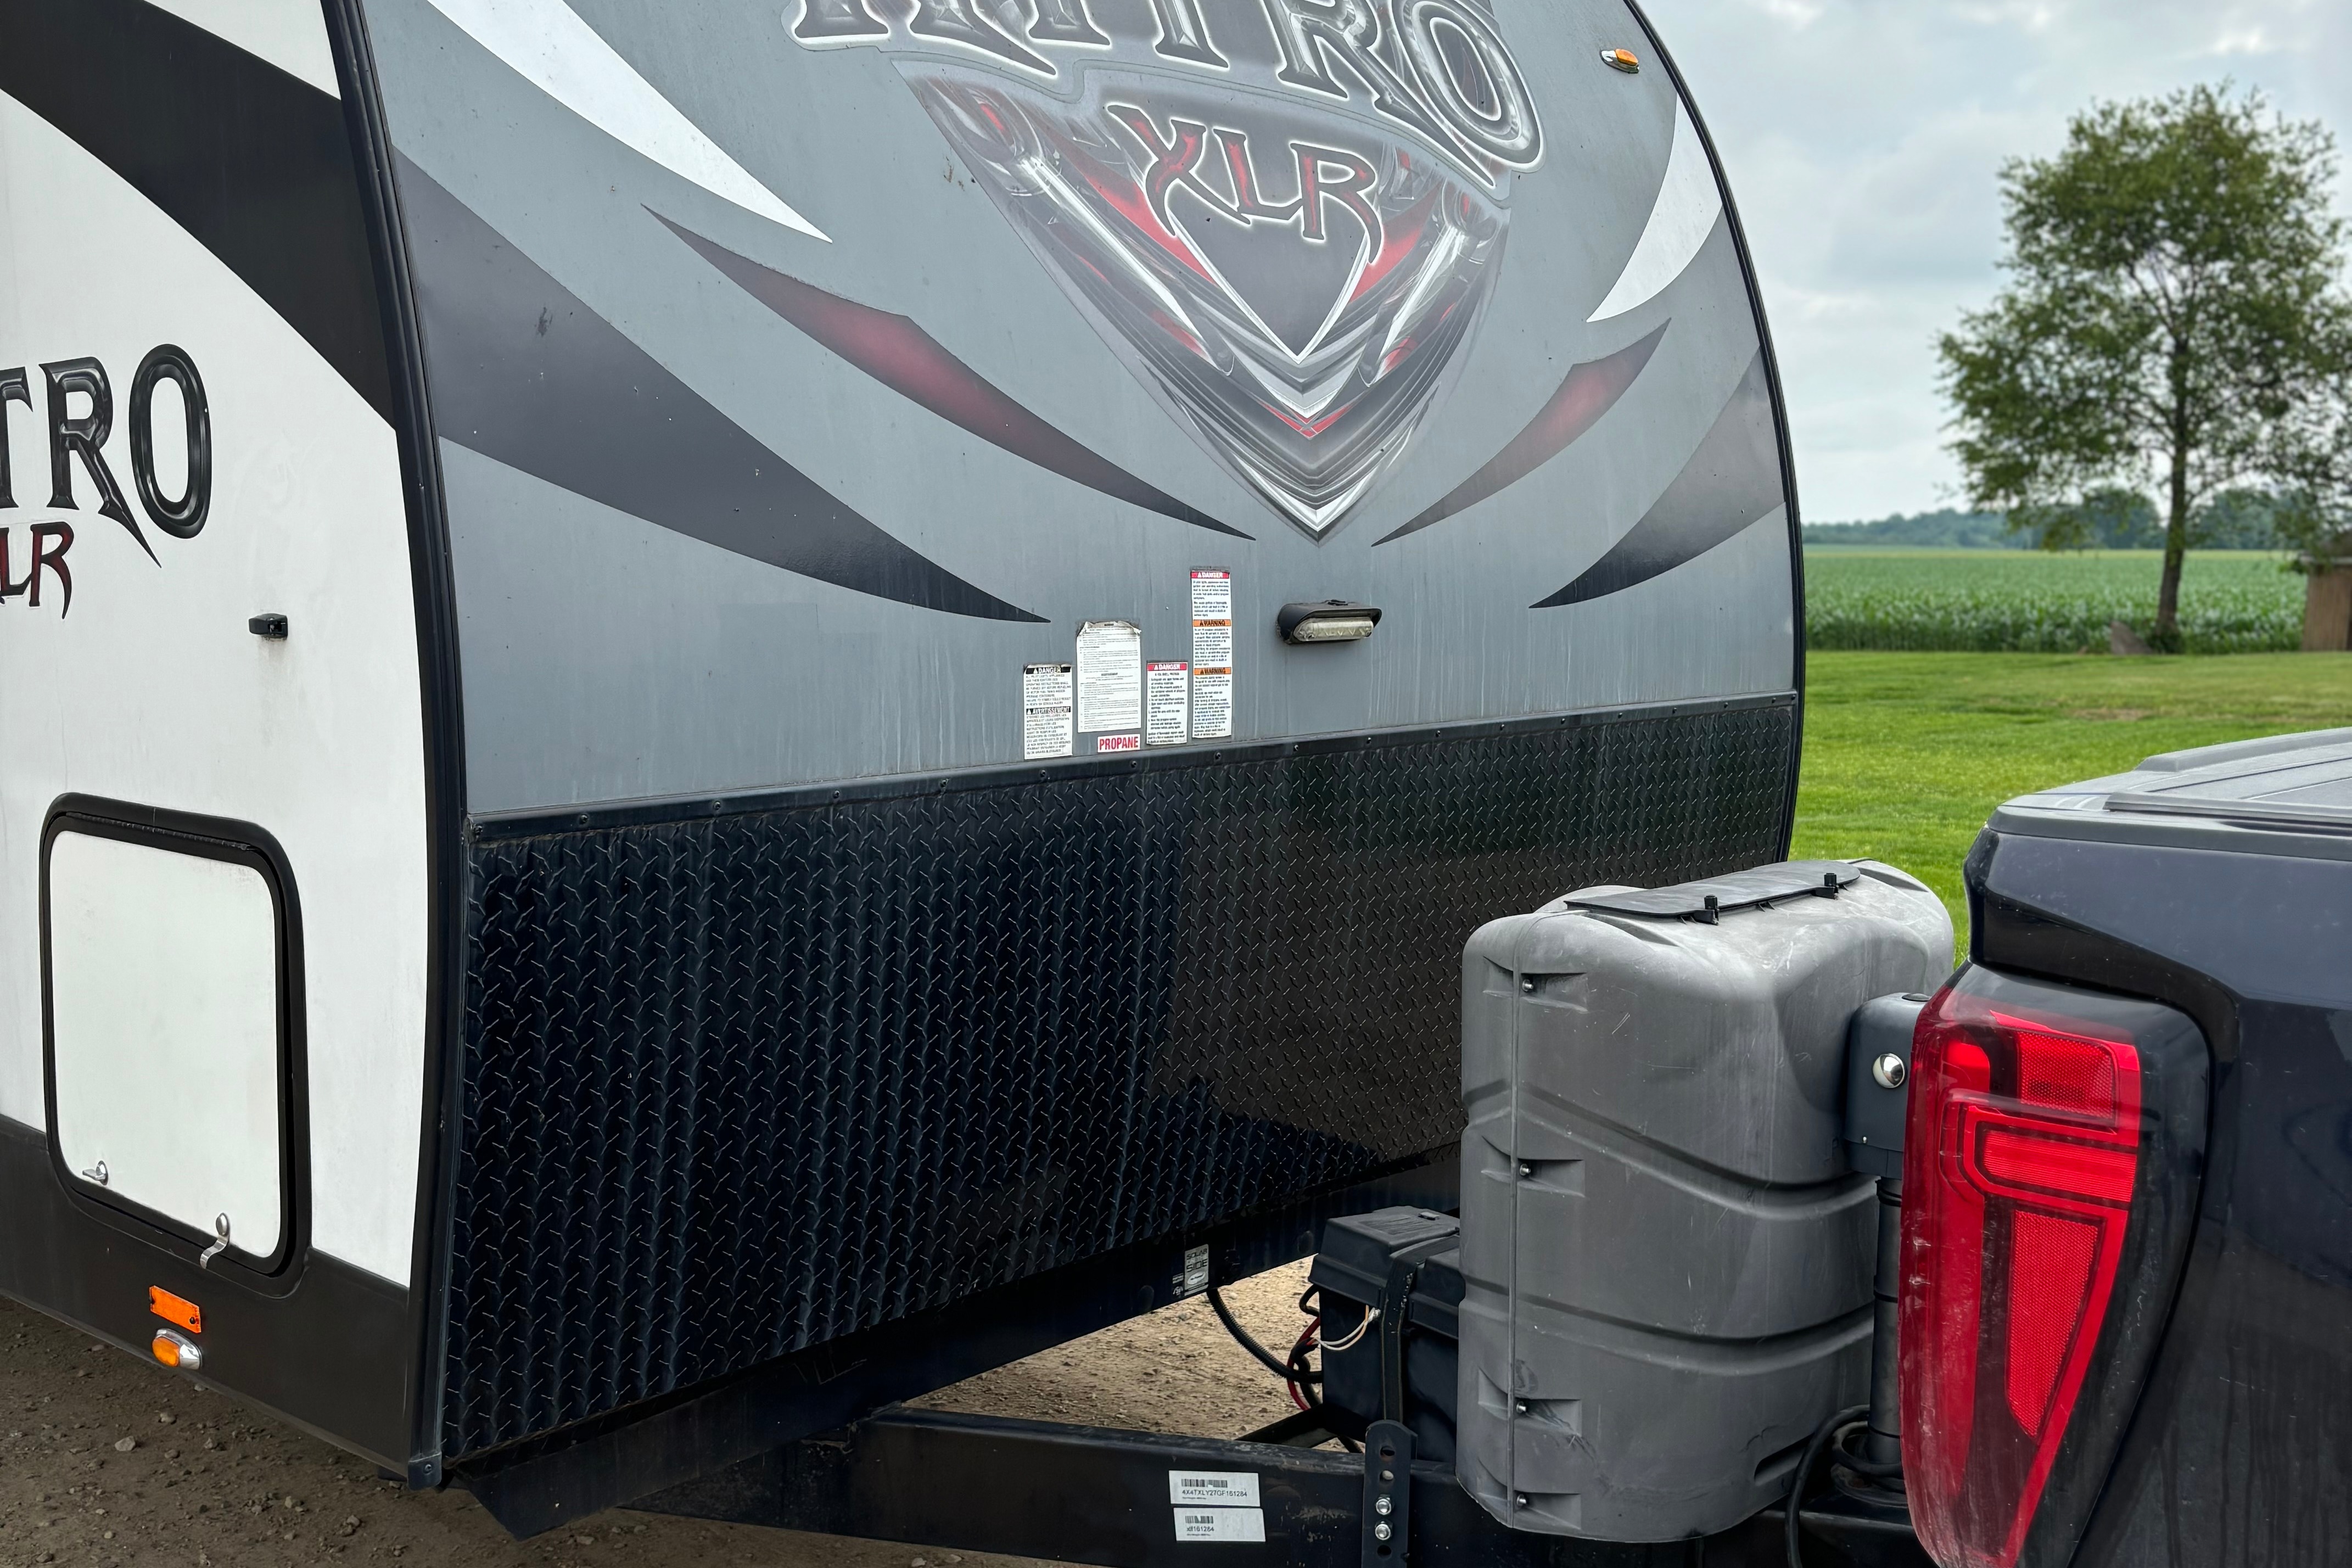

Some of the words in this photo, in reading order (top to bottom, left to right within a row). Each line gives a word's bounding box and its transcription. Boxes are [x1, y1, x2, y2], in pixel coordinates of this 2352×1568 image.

[1104, 101, 1385, 266] XLR
[0, 520, 75, 619] LR
[1099, 737, 1138, 751] PROPANE
[1186, 1258, 1208, 1273] SIDE
